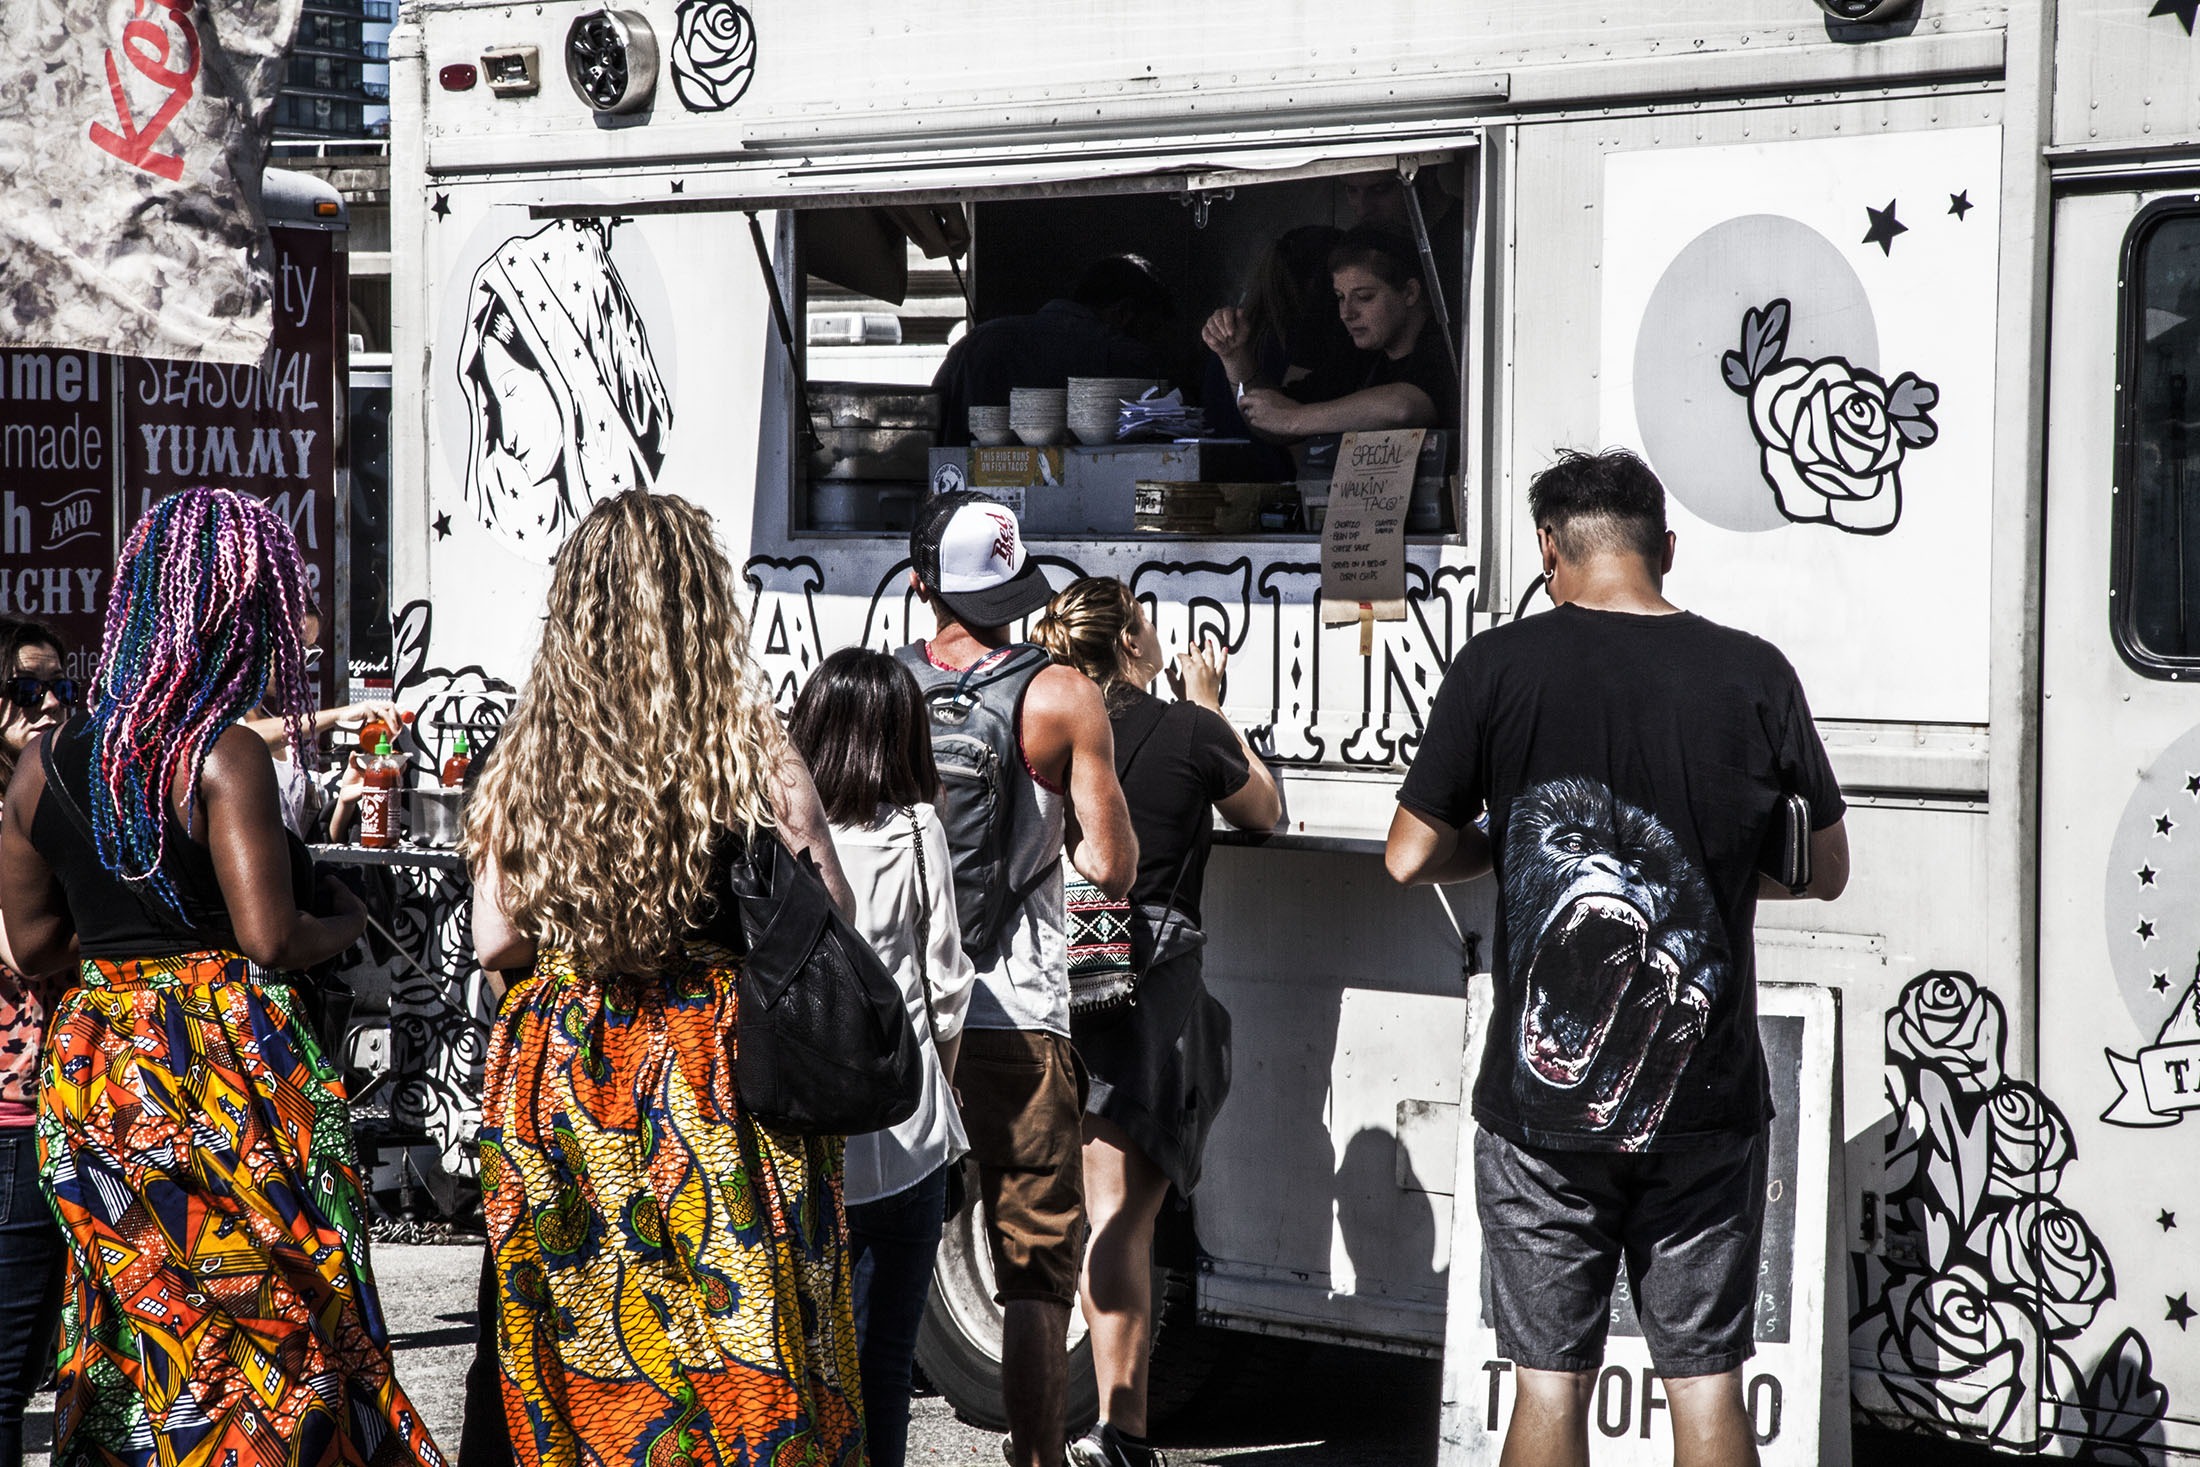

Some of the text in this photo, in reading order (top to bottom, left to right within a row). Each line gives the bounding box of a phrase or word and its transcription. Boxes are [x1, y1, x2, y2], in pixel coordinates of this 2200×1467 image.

[89, 0, 202, 182] Ke
[273, 252, 317, 327] ty
[0, 352, 98, 402] mel
[139, 348, 318, 413] SEASONAL
[139, 423, 318, 479] YUMMY
[980, 451, 1030, 461] THIS RIDE RUNS
[981, 461, 1029, 472] ON FISH TACOS
[1352, 437, 1404, 467] SPECIAL
[50, 499, 93, 540] AND
[985, 512, 1008, 560] Red
[348, 656, 389, 677] egend
